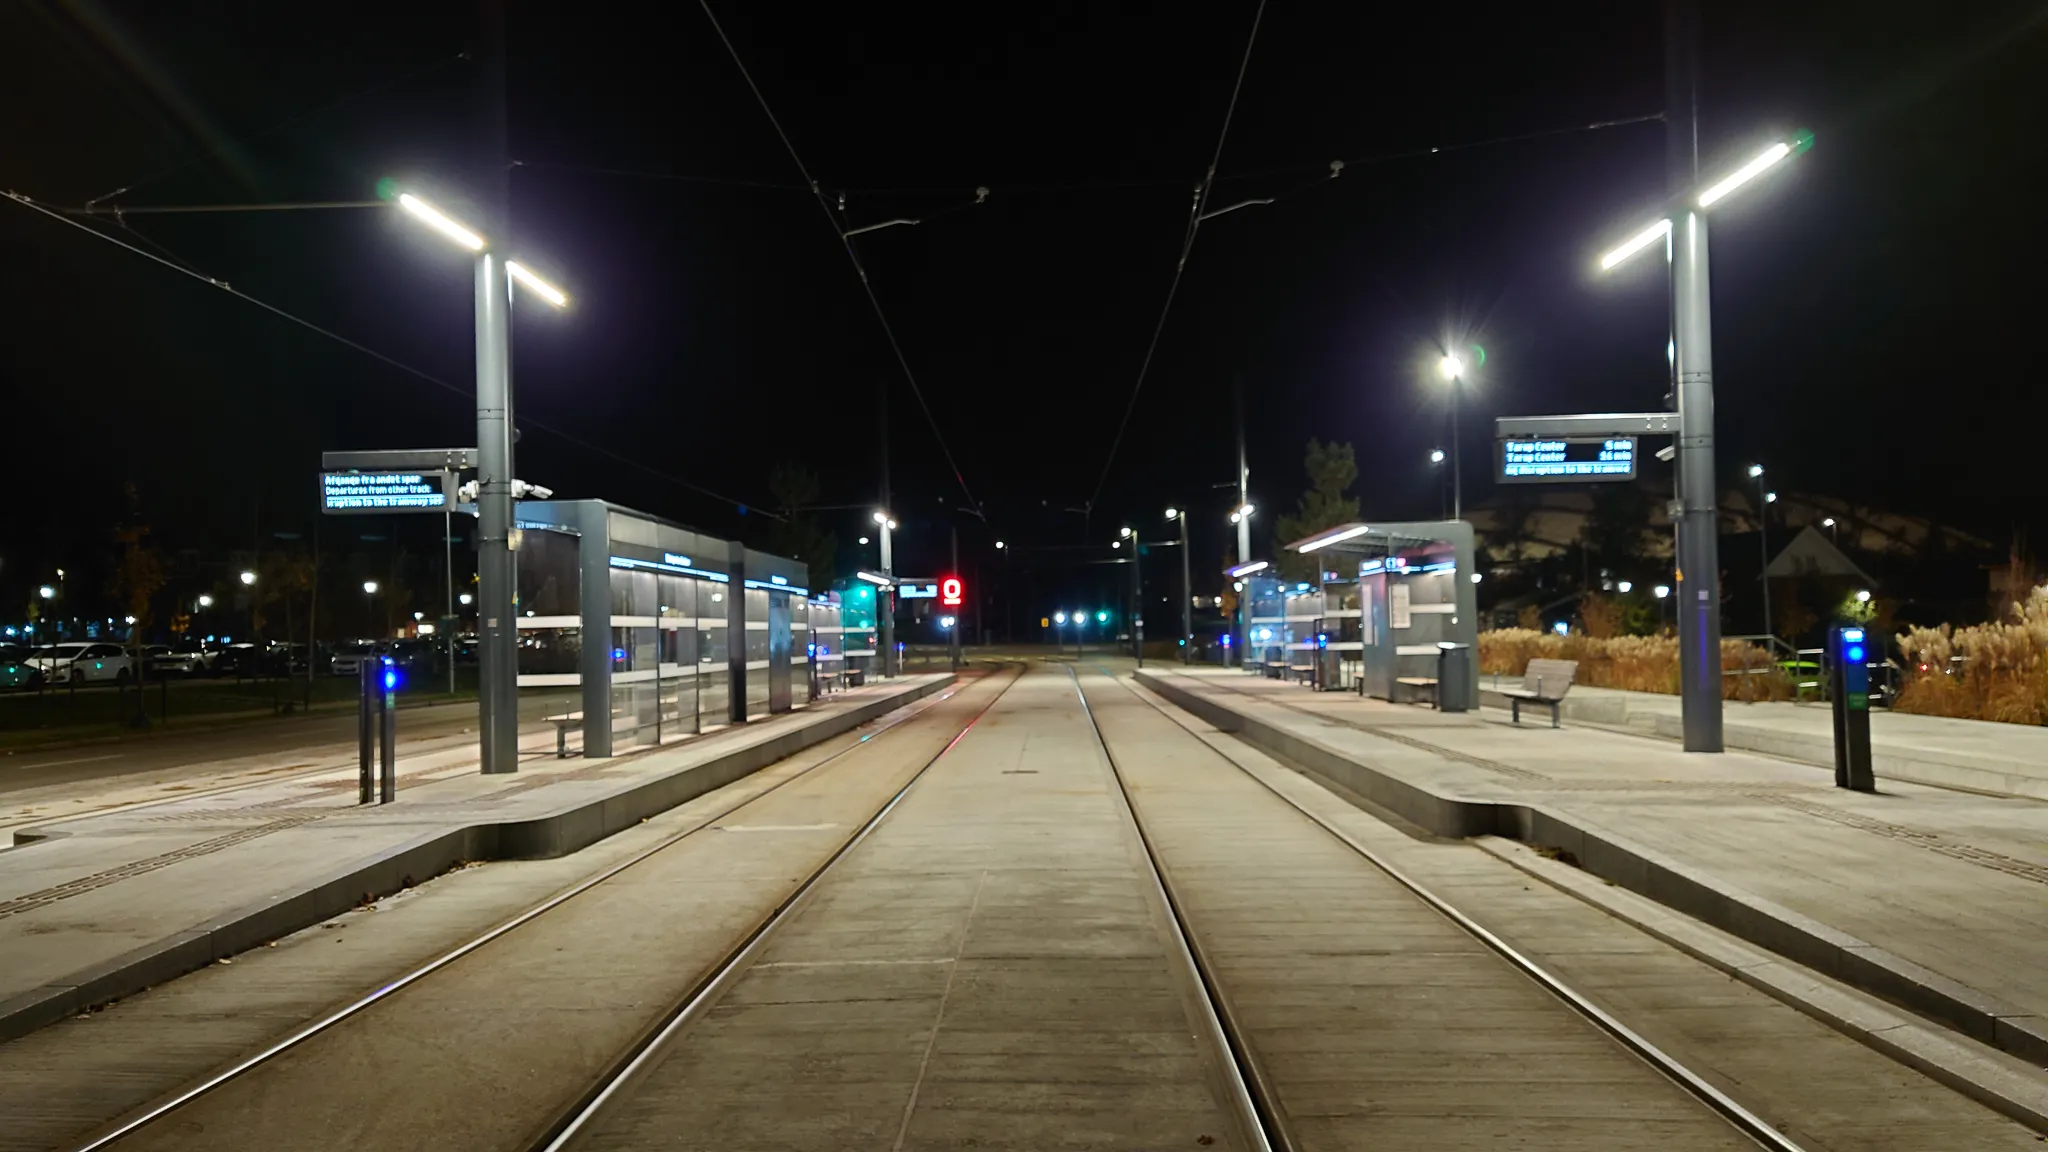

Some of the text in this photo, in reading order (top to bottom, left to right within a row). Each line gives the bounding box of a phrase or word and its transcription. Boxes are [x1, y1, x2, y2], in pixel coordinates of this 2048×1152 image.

[1507, 442, 1534, 452] Tarup
[1535, 442, 1566, 451] Center
[1614, 440, 1632, 450] min
[1507, 452, 1533, 462] Tarup
[1535, 452, 1566, 462] Center
[1614, 451, 1632, 460] min
[361, 475, 375, 484] fra
[376, 475, 400, 484] andet
[402, 475, 421, 485] spor
[326, 485, 430, 495] Departures from other track
[363, 497, 372, 507] to
[374, 497, 388, 506] the
[389, 496, 428, 507] tramway
